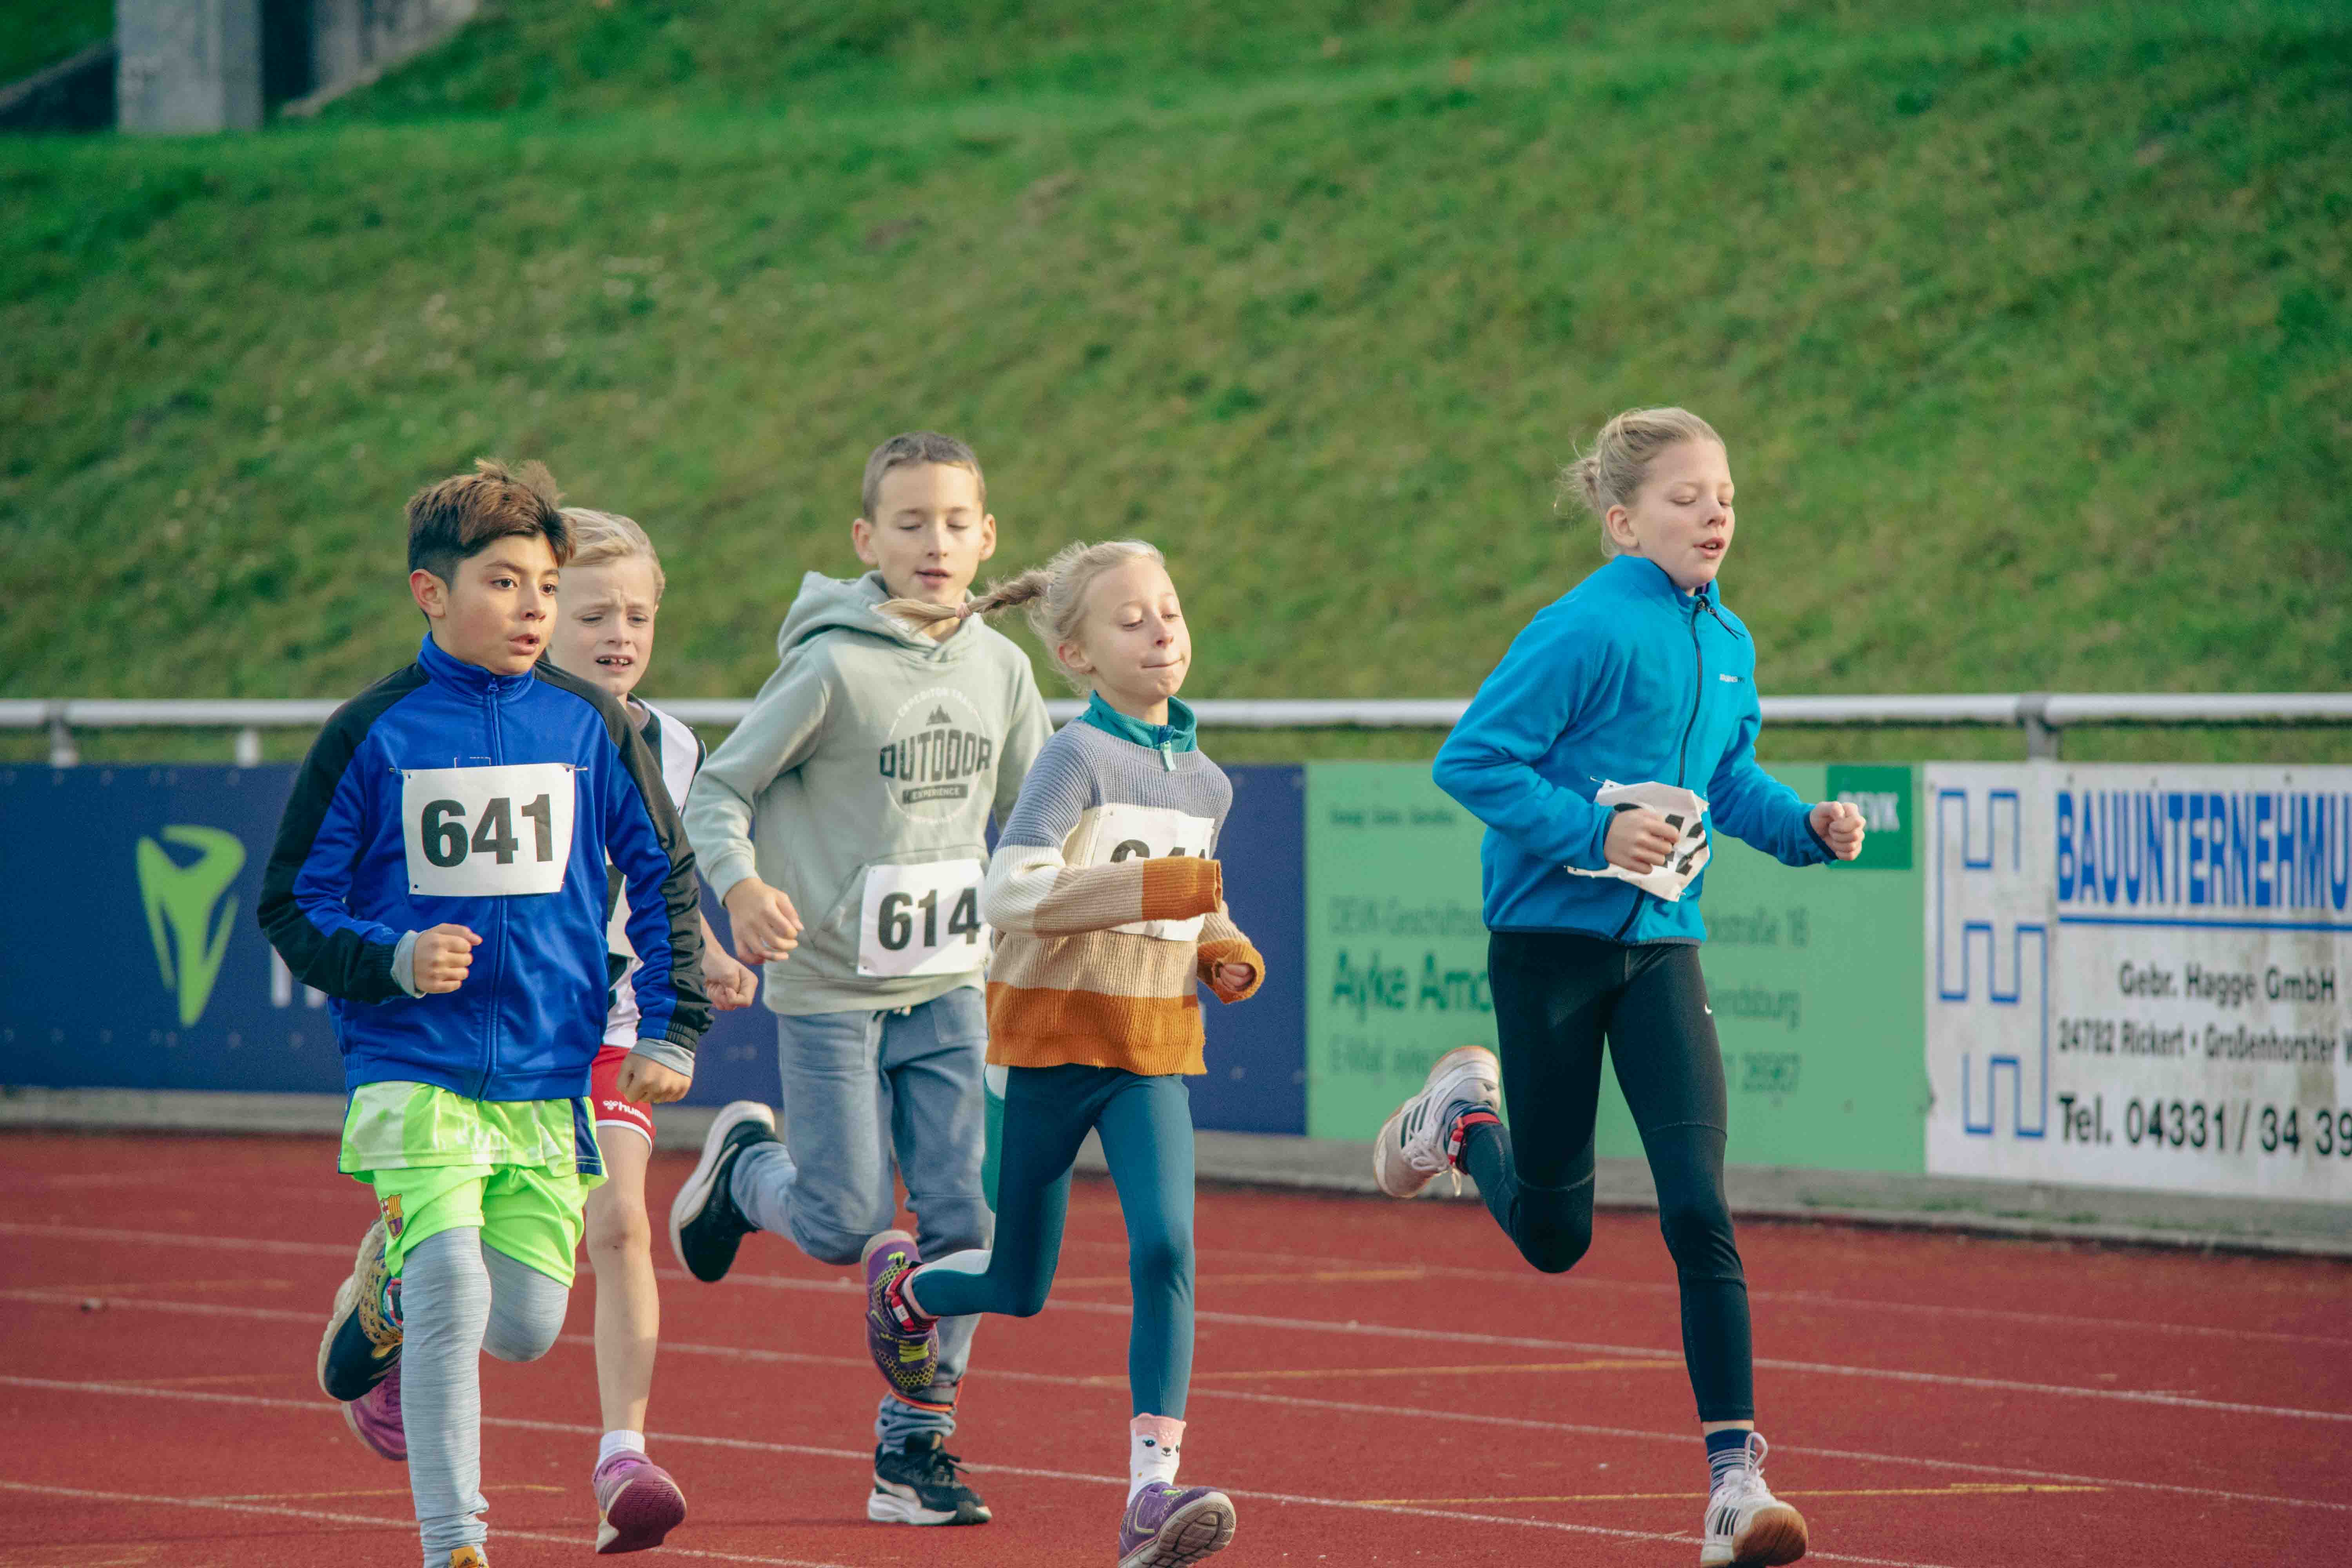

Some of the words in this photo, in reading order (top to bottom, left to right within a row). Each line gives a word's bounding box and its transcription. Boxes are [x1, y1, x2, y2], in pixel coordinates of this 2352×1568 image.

[880, 728, 993, 780] OUTDOOR
[911, 786, 960, 800] EXPERIENCE
[421, 793, 553, 868] 641
[878, 887, 981, 951] 614
[2119, 960, 2178, 997] Gebr.
[2185, 962, 2257, 1007] Hagge
[2265, 965, 2336, 1004] GmbH
[2058, 1094, 2112, 1144] Tel.
[2259, 1105, 2300, 1156] 34
